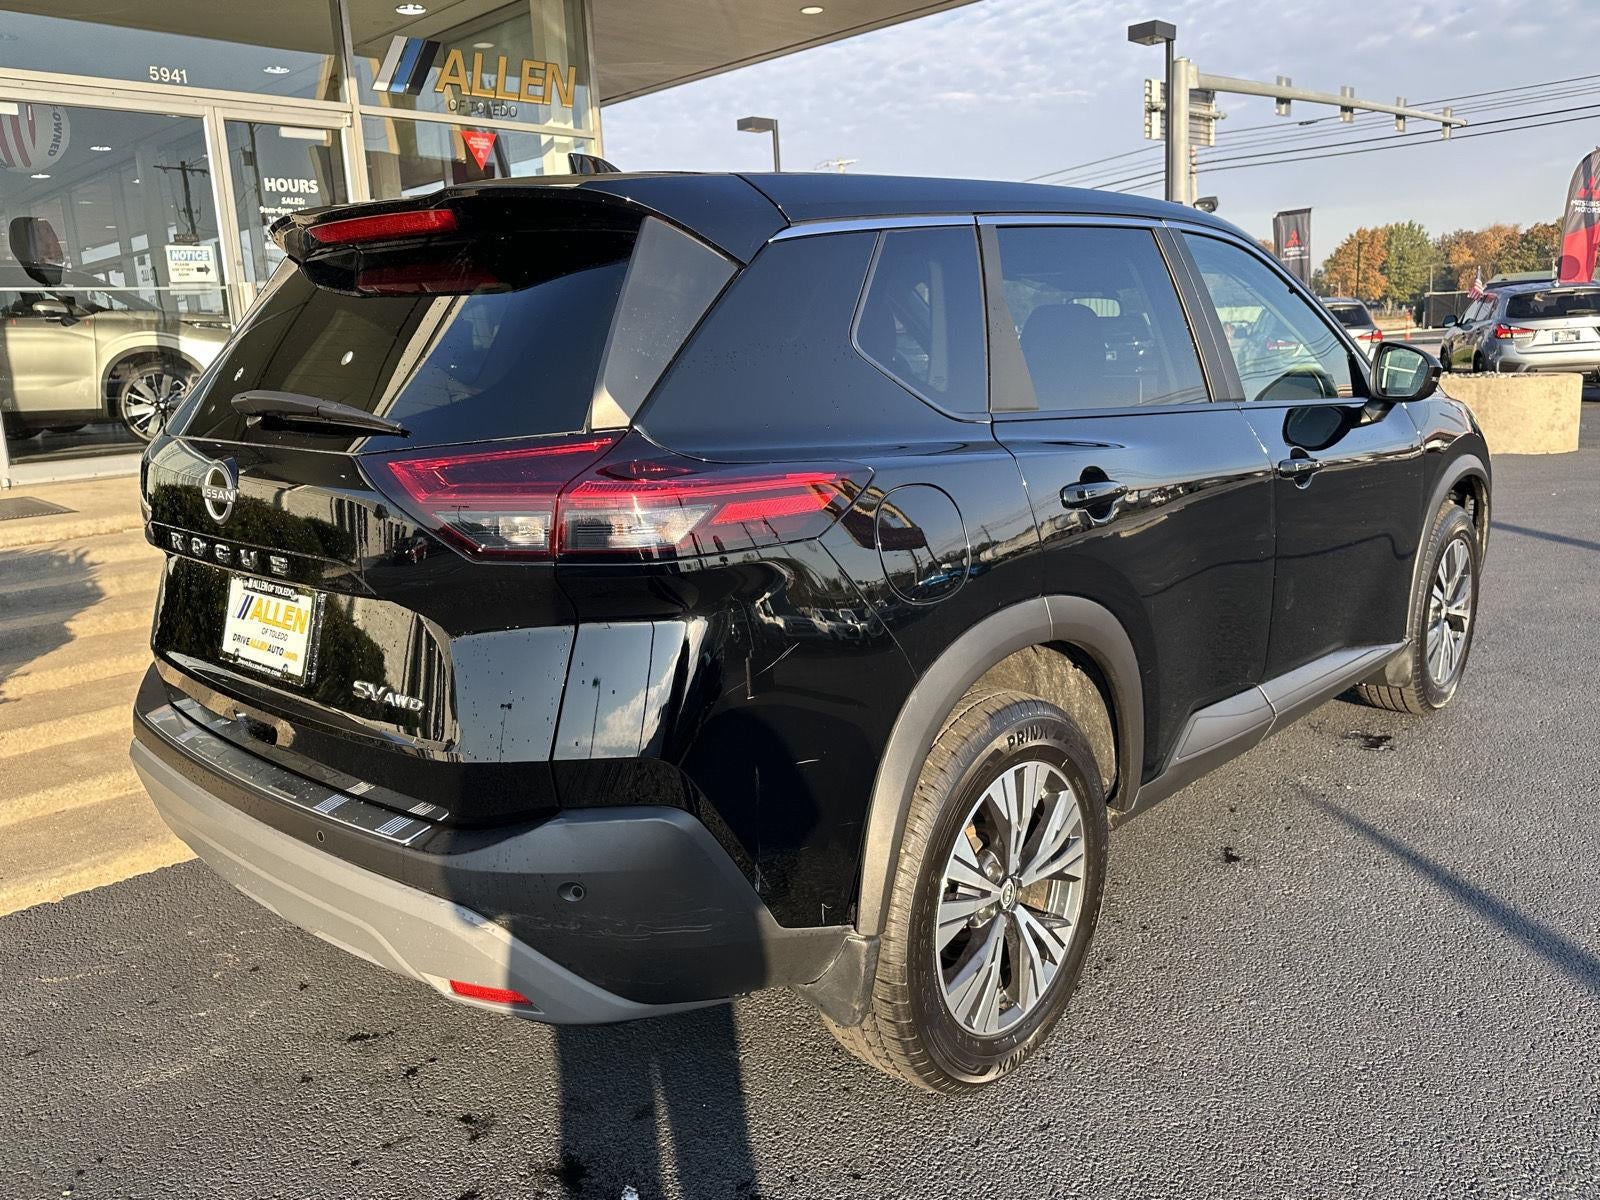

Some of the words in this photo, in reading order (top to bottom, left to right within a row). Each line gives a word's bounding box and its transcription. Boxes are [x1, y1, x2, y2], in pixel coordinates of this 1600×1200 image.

[149, 65, 188, 84] 5941
[434, 48, 577, 109] ALLEN
[448, 99, 465, 112] OF
[470, 101, 518, 118] TOLEDO
[47, 105, 63, 157] -OWNED
[263, 177, 319, 194] HOURS
[171, 251, 209, 260] NOTICE
[170, 531, 289, 577] ROGUE
[252, 578, 268, 592] ALLEN
[275, 585, 295, 597] TOLEDO
[250, 597, 309, 634] ALLEN
[261, 627, 269, 635] OF
[269, 629, 288, 641] TOLEDO
[352, 680, 387, 702] SV
[384, 692, 424, 712] AWD
[1007, 725, 1048, 751] PRINX
